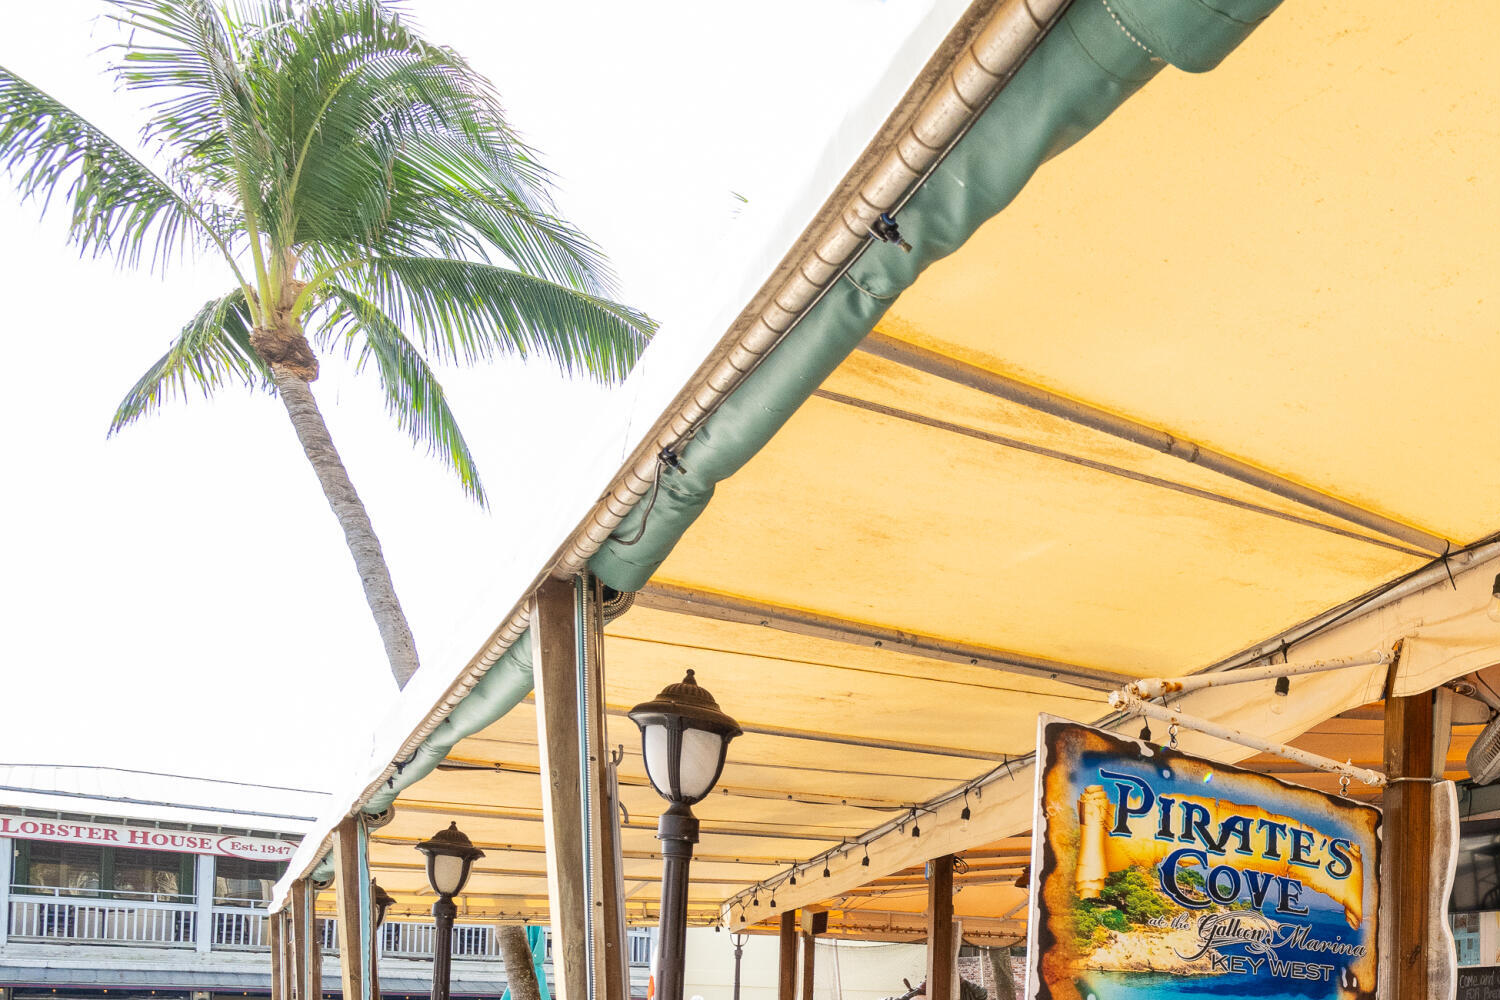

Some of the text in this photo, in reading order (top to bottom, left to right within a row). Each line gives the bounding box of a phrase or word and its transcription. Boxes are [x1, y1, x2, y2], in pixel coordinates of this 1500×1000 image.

[0, 818, 212, 850] LOBSTER HOUSE
[1099, 767, 1353, 880] PIRATE'S
[231, 841, 291, 855] Est. 1947
[1158, 847, 1310, 916] COVE
[1148, 910, 1367, 958] at the Galleon Marina
[1211, 953, 1335, 982] KEY WEST
